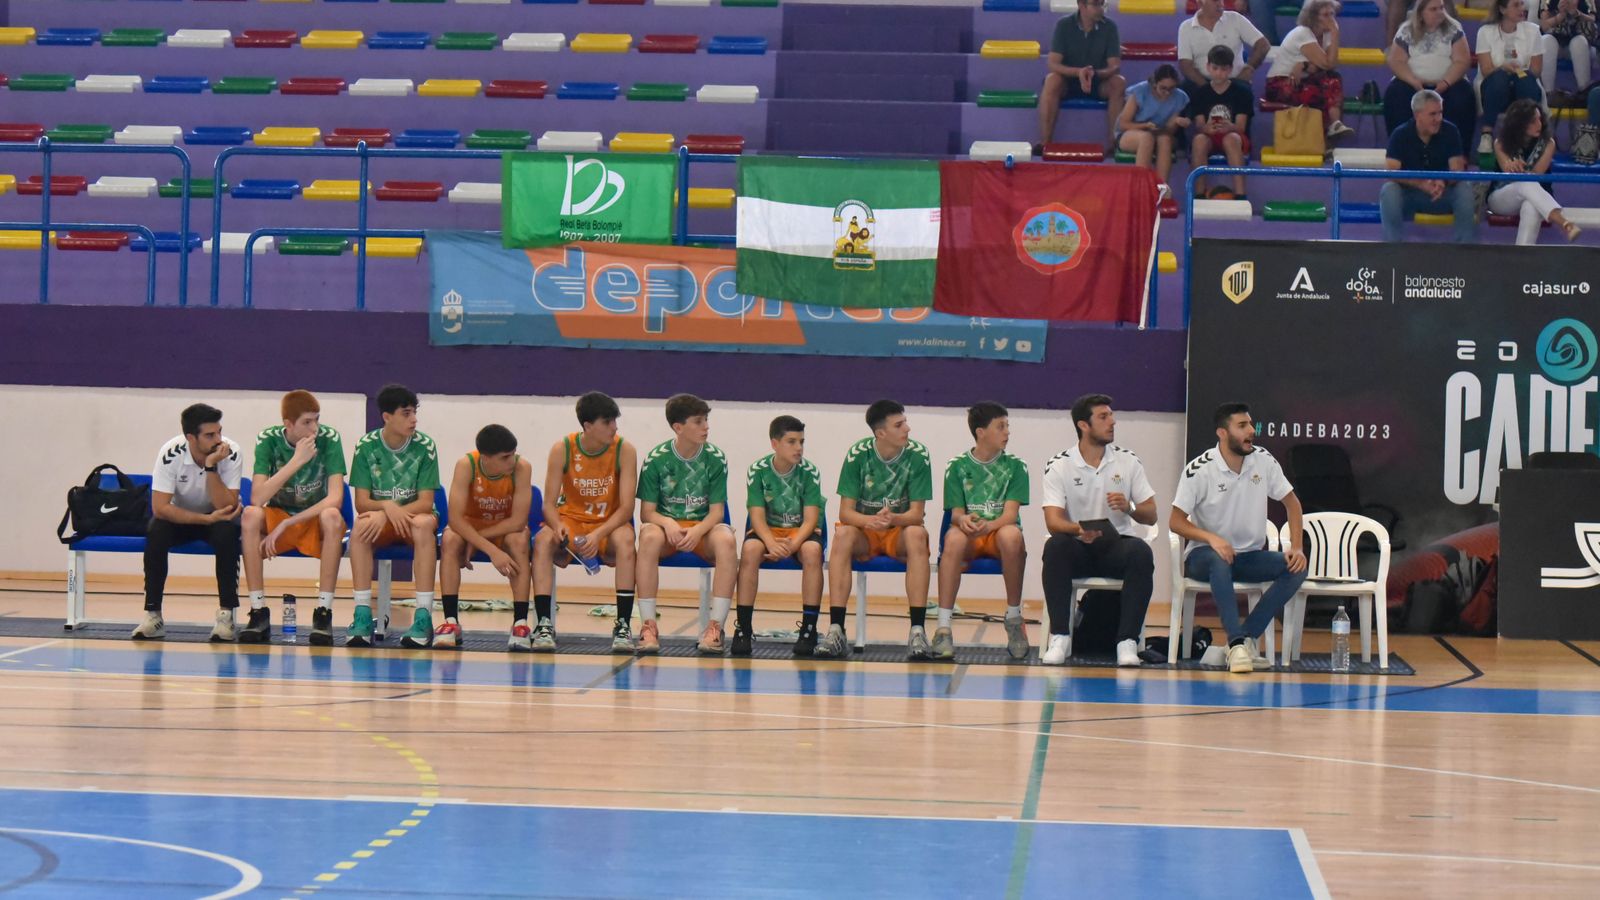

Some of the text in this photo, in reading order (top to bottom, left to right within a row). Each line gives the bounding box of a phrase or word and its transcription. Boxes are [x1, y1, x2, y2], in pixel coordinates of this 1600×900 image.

[560, 230, 584, 241] 1907
[593, 233, 621, 243] 2007
[1228, 270, 1248, 296] 100
[1405, 274, 1466, 288] baloncesto
[1522, 281, 1578, 297] cajasur
[1301, 292, 1330, 300] Andalucía
[898, 337, 967, 348] www.lalinea.es
[573, 476, 613, 488] FOREVER
[580, 486, 609, 497] GREEN
